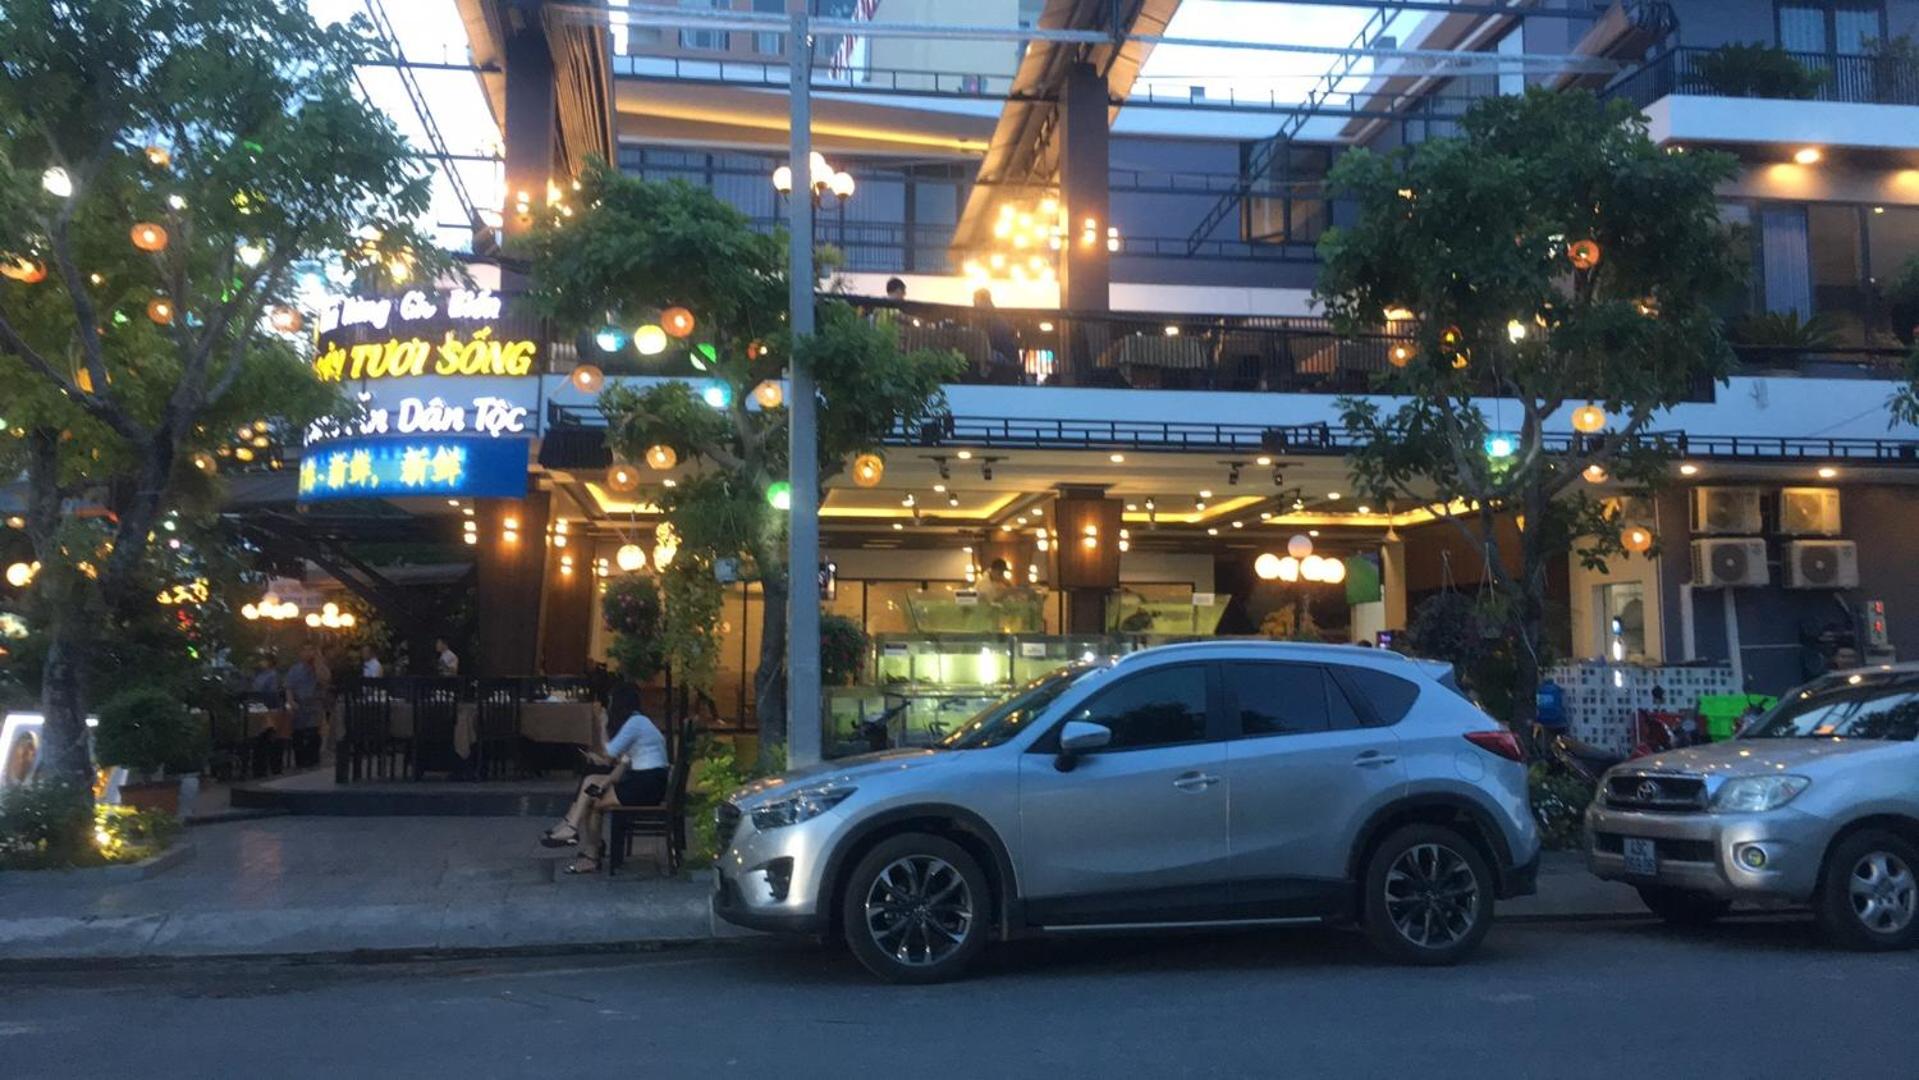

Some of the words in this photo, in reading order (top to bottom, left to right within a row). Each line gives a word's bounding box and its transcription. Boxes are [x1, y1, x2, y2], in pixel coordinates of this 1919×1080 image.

[350, 337, 431, 380] TƯƠI
[435, 325, 537, 377] SỐNG
[397, 396, 466, 434] Dân
[472, 395, 528, 438] Tộc
